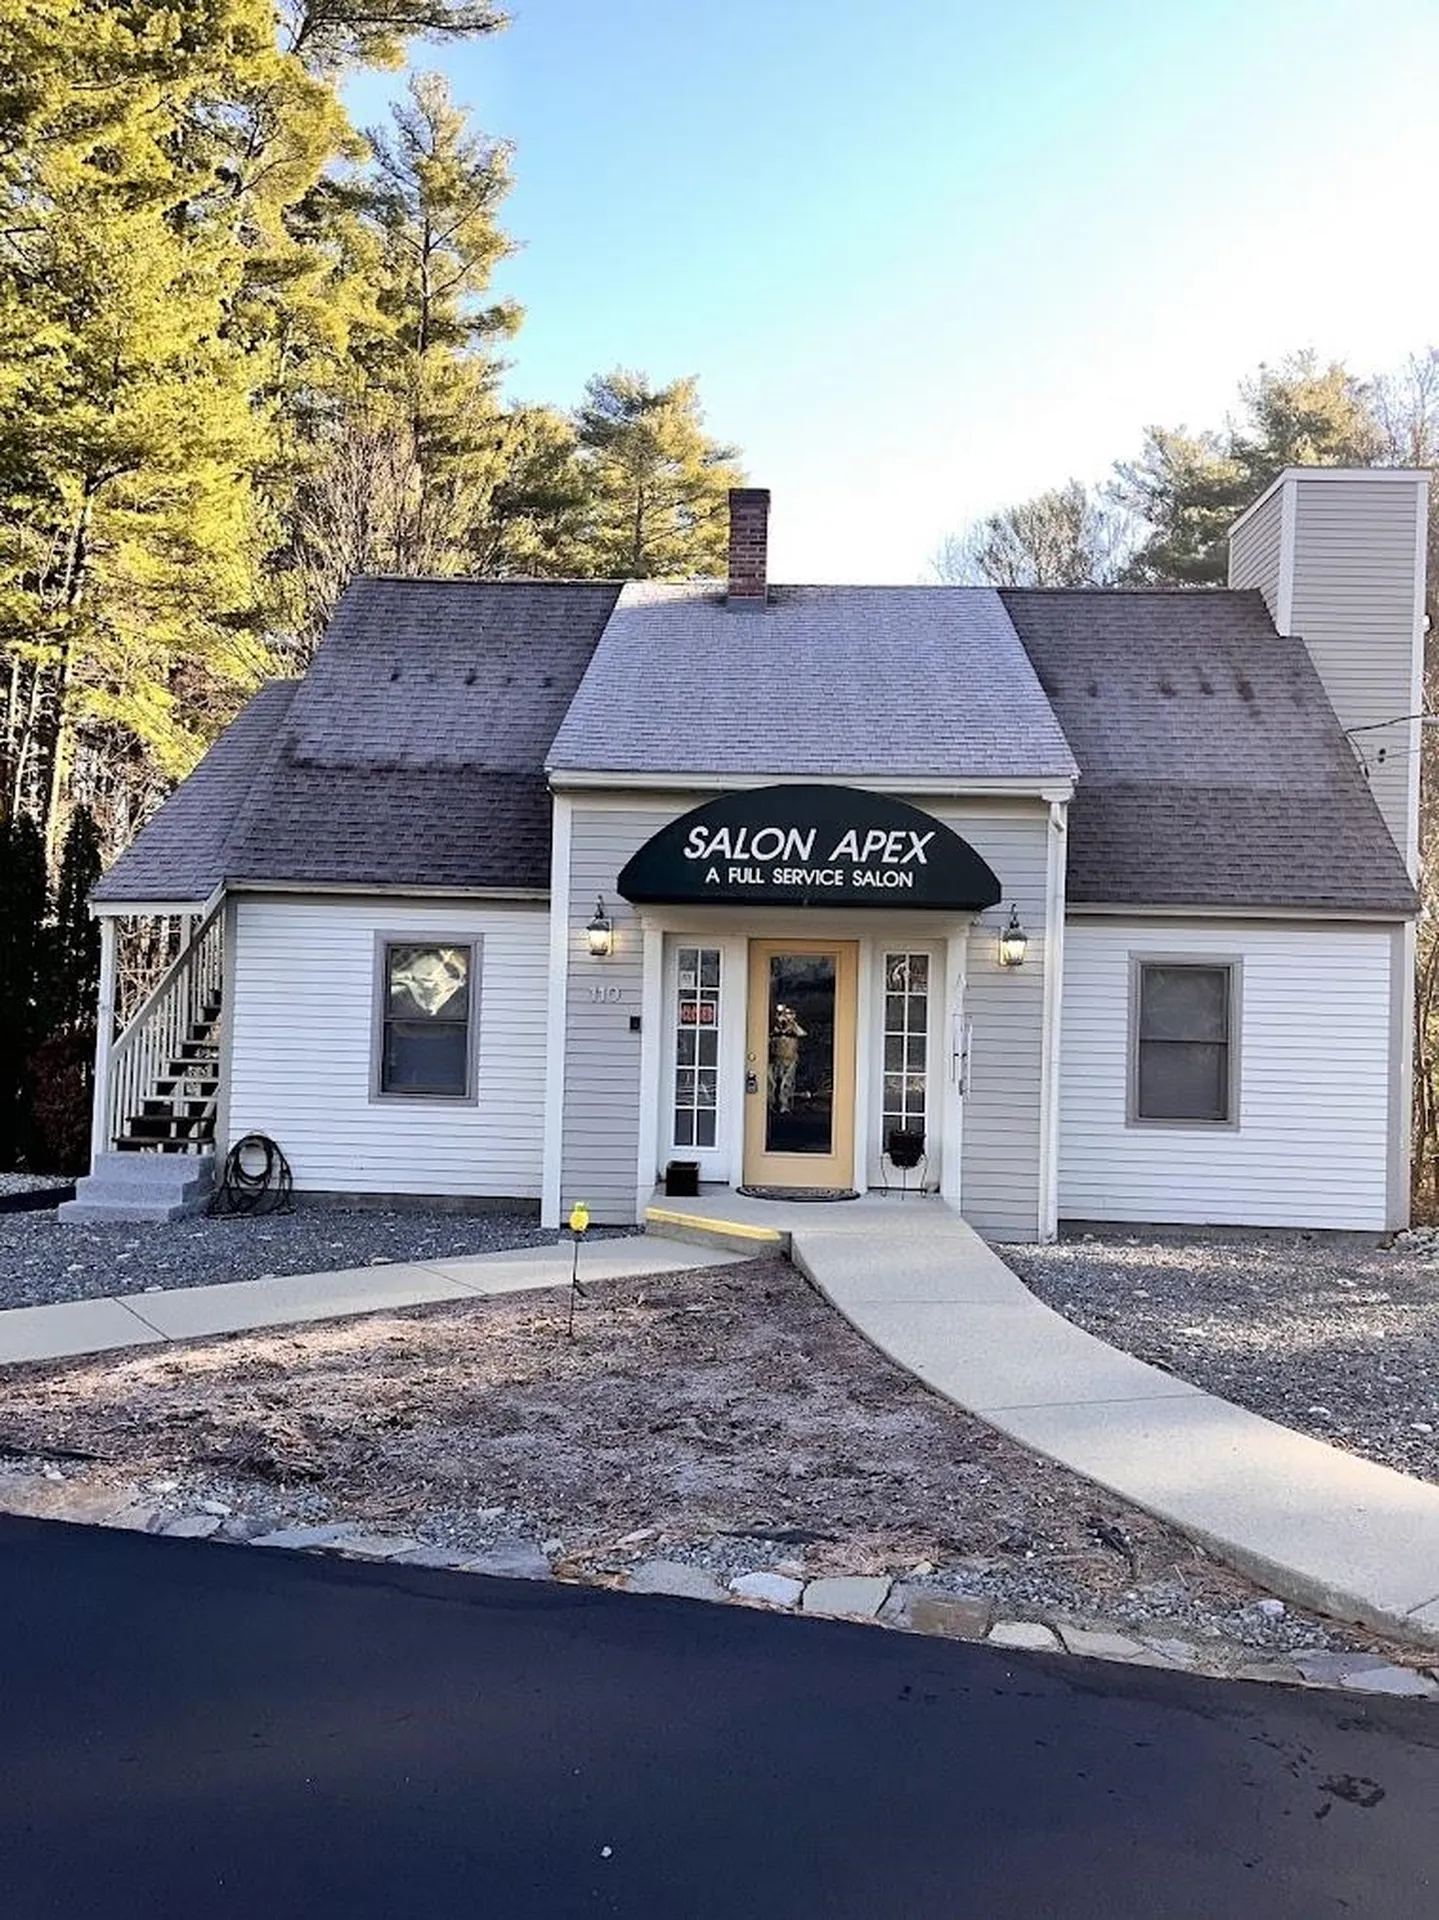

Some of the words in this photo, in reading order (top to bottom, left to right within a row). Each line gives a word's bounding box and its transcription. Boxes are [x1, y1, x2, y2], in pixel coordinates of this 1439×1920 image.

[683, 826, 817, 860] SALON
[828, 829, 935, 864] APEX
[705, 867, 720, 883] A
[728, 867, 764, 883] FULL
[772, 867, 844, 885] SERVICE
[852, 869, 913, 887] SALON
